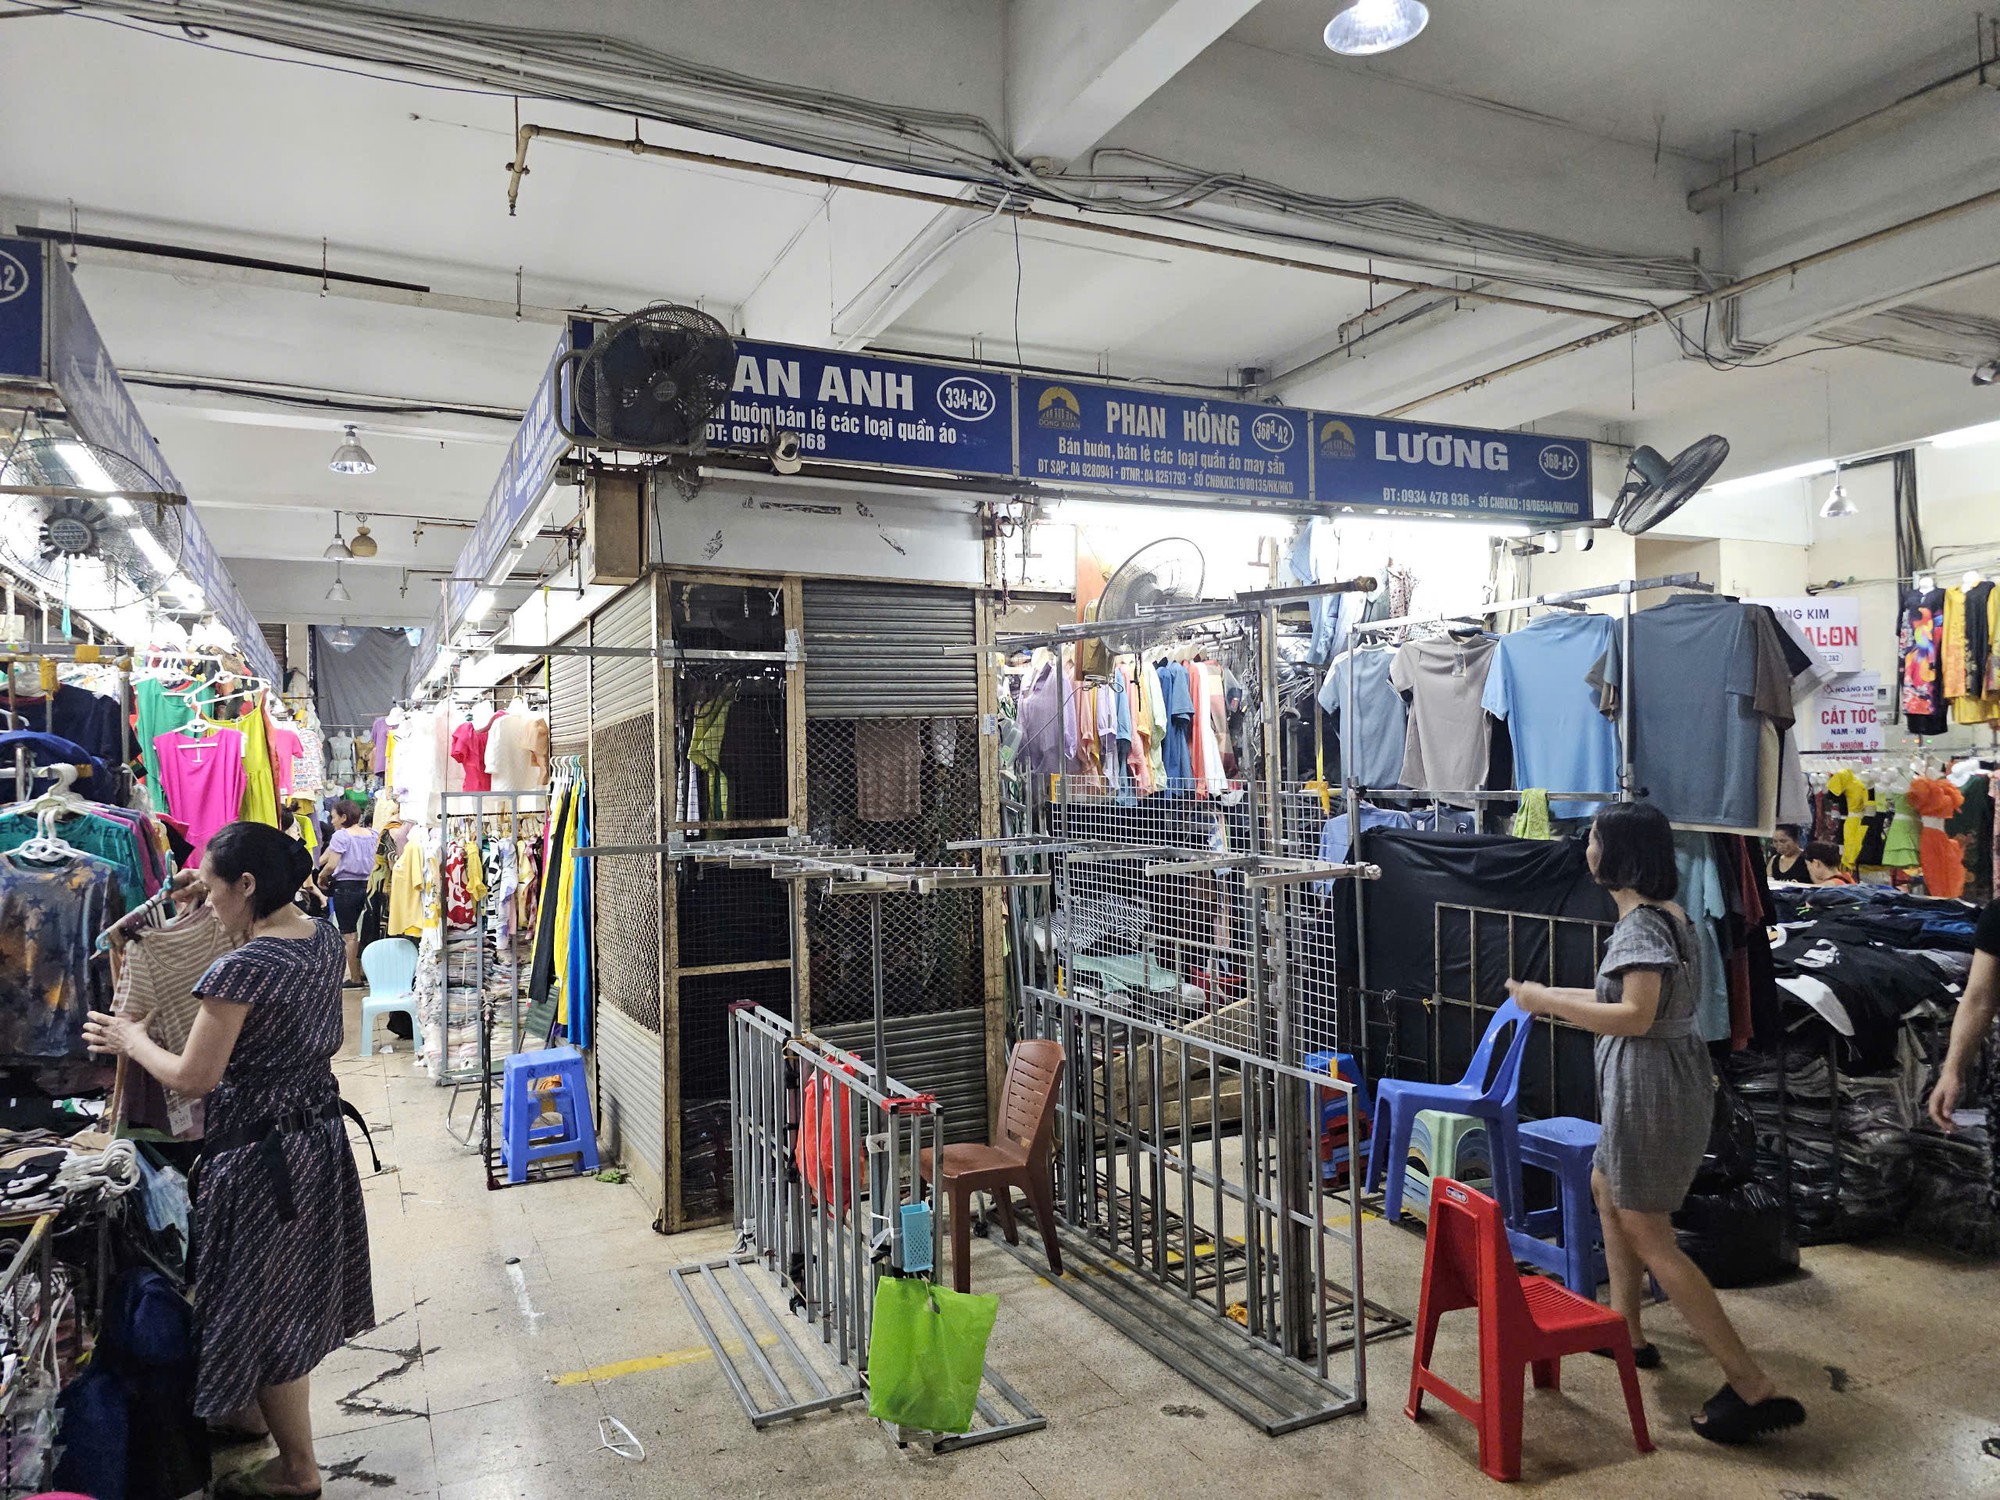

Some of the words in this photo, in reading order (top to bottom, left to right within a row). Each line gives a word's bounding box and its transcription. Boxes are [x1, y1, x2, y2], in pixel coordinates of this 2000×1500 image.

[817, 365, 914, 411] ANH
[945, 387, 988, 412] 334-A2
[730, 400, 771, 425] buôn
[776, 404, 806, 429] bán
[811, 406, 826, 431] lẻ
[831, 411, 860, 434] các
[864, 415, 893, 441] loại
[897, 416, 934, 443] quần
[939, 421, 957, 445] áo
[1106, 400, 1166, 439] PHAN
[1183, 402, 1240, 447] HỒNG
[1058, 436, 1081, 456] Bán
[1117, 443, 1138, 461] bán
[1140, 444, 1151, 463] lẻ
[1153, 446, 1173, 465] các
[1178, 449, 1198, 469] loại
[1201, 450, 1226, 469] quần
[1228, 453, 1241, 471] áo
[1243, 458, 1265, 475] may
[1267, 455, 1285, 475] sẵn
[1375, 430, 1509, 471] LƯƠNG
[1543, 452, 1574, 471] 368-A2
[1038, 458, 1049, 473] ĐT
[1082, 463, 1114, 479] 9280941
[1155, 469, 1187, 485] 8251793
[1429, 491, 1449, 505] 478
[1451, 492, 1470, 507] 936
[1807, 608, 1830, 620] KIM
[1821, 704, 1847, 725] CẮT
[1850, 706, 1877, 724] TÓC
[1855, 727, 1867, 735] NỮ
